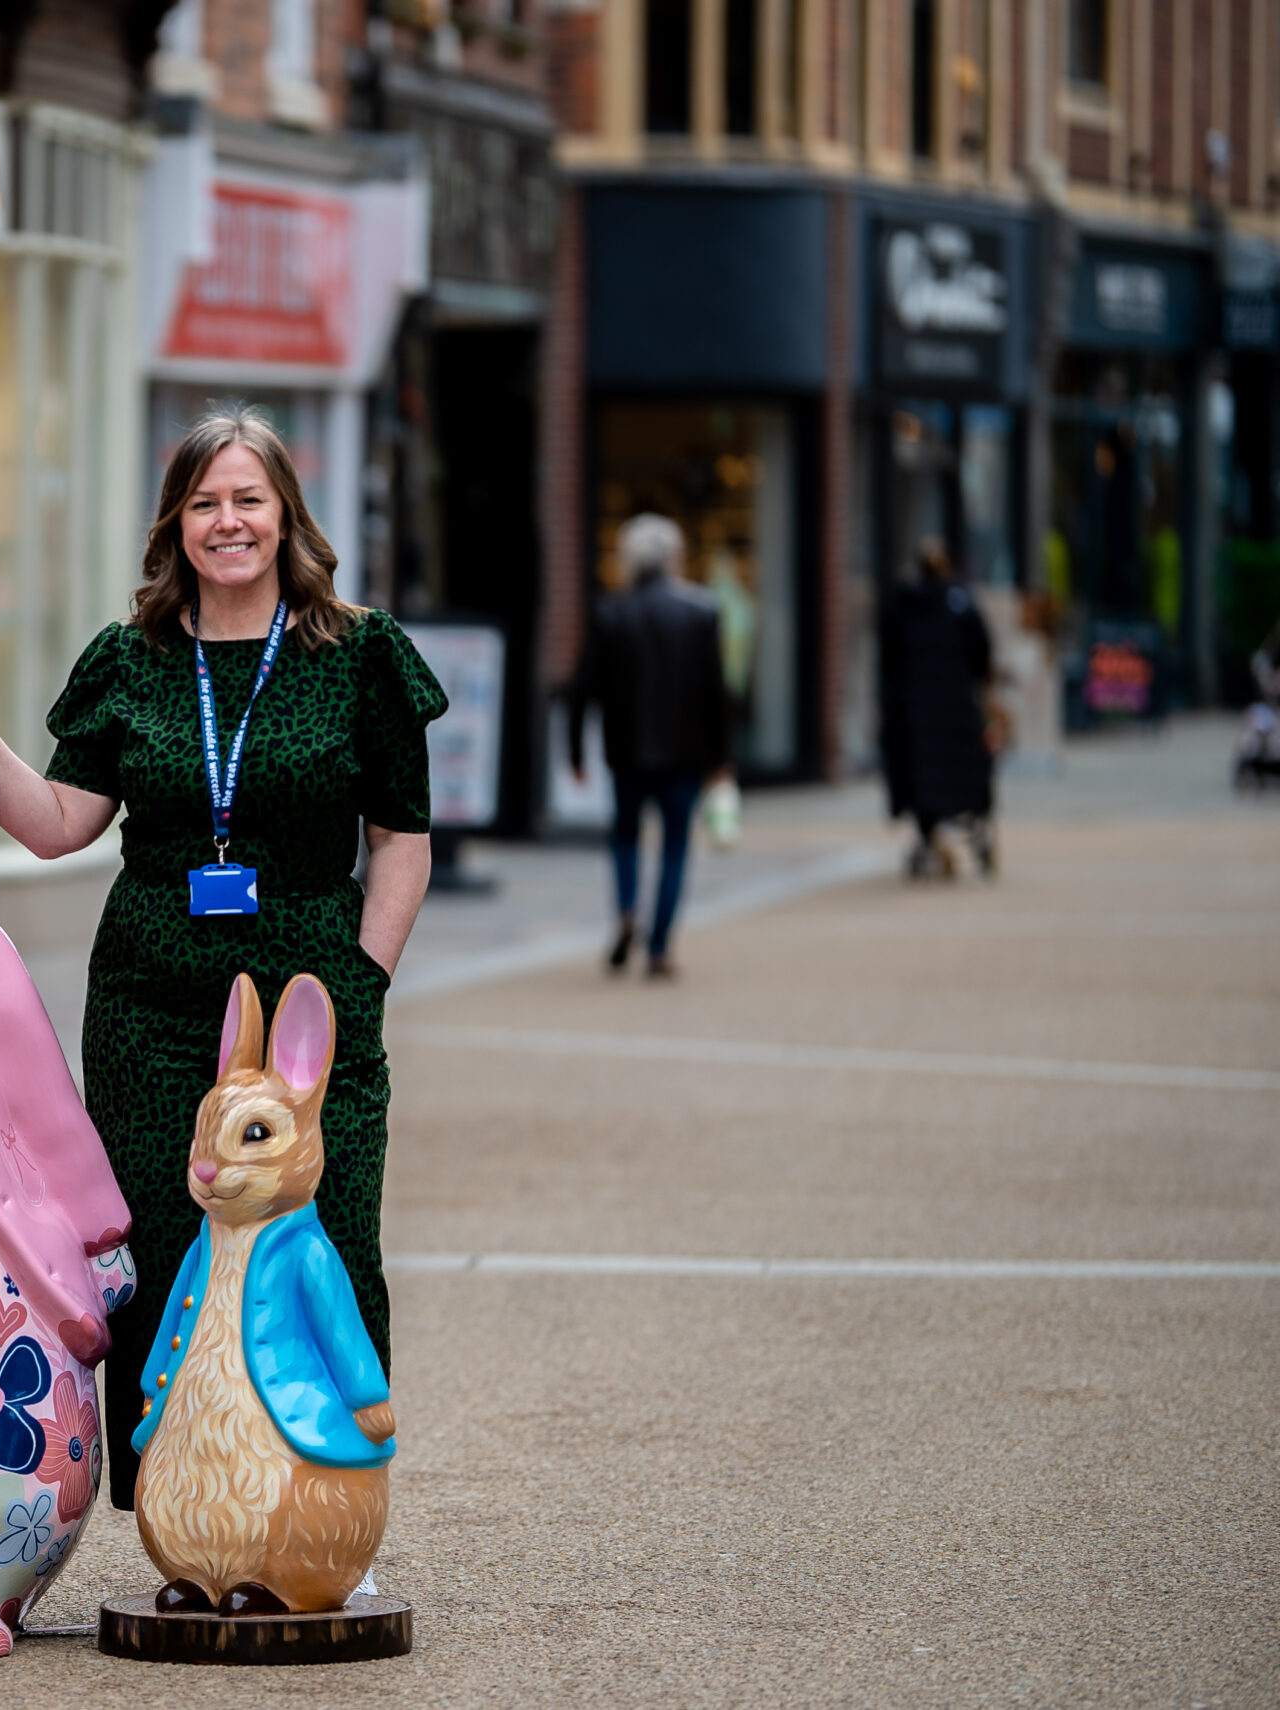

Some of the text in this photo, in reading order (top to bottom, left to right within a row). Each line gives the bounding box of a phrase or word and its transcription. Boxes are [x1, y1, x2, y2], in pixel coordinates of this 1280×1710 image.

[263, 646, 275, 662] the
[270, 624, 282, 647] great
[200, 678, 210, 694] the
[200, 694, 214, 719] great
[204, 719, 217, 750] waddle
[231, 730, 245, 761] waddle
[207, 750, 219, 760] of
[225, 762, 237, 788] great
[221, 789, 233, 808] the
